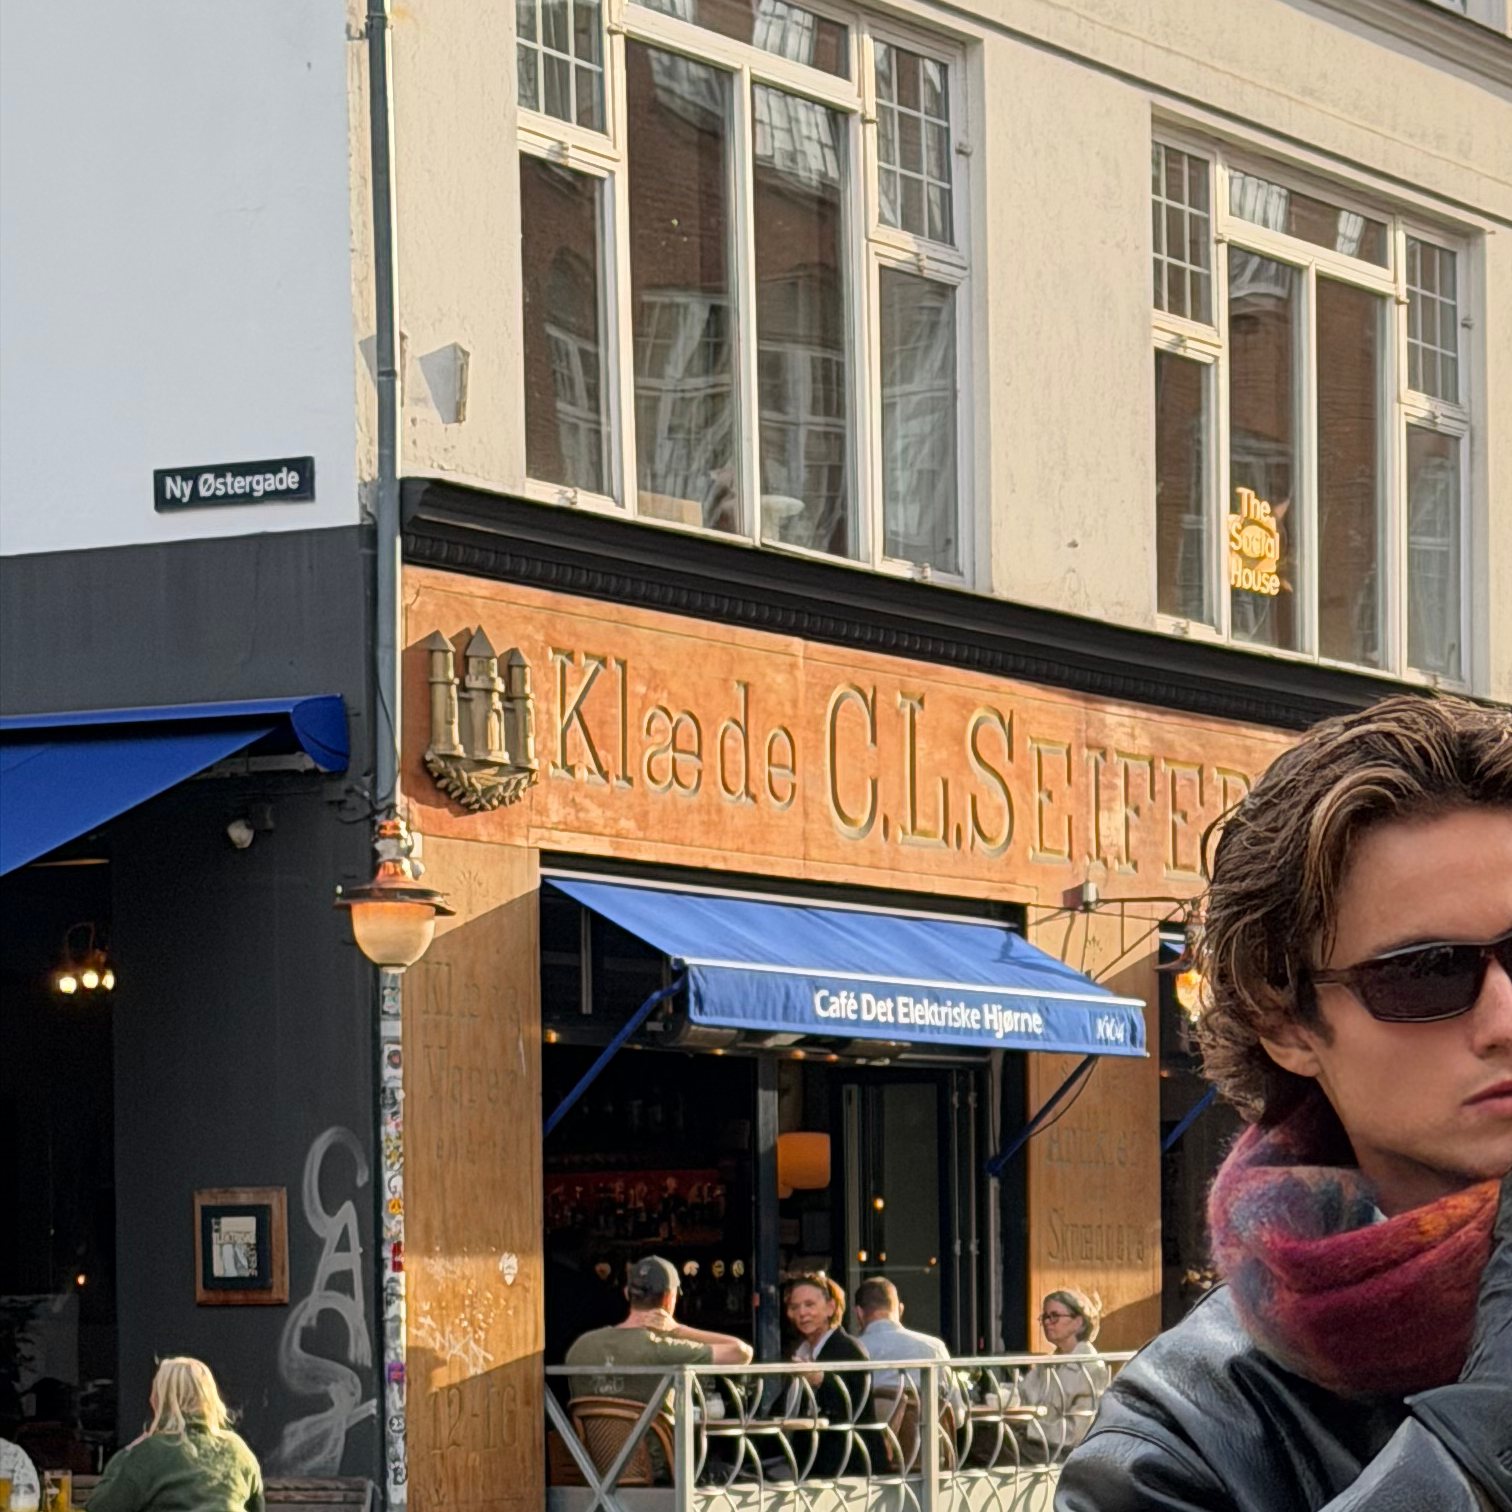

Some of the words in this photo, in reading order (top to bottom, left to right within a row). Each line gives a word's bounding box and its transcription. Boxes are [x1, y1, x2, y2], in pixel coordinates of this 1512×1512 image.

[165, 475, 193, 503] Ny
[198, 466, 300, 499] Østergade
[1235, 486, 1271, 522] The
[1230, 521, 1280, 561] Social
[1230, 557, 1280, 596] House
[549, 647, 797, 811] Klæde
[814, 988, 858, 1020] Café
[861, 993, 894, 1024] Det
[897, 996, 981, 1030] Elektriske
[983, 1003, 1043, 1039] Hjørne
